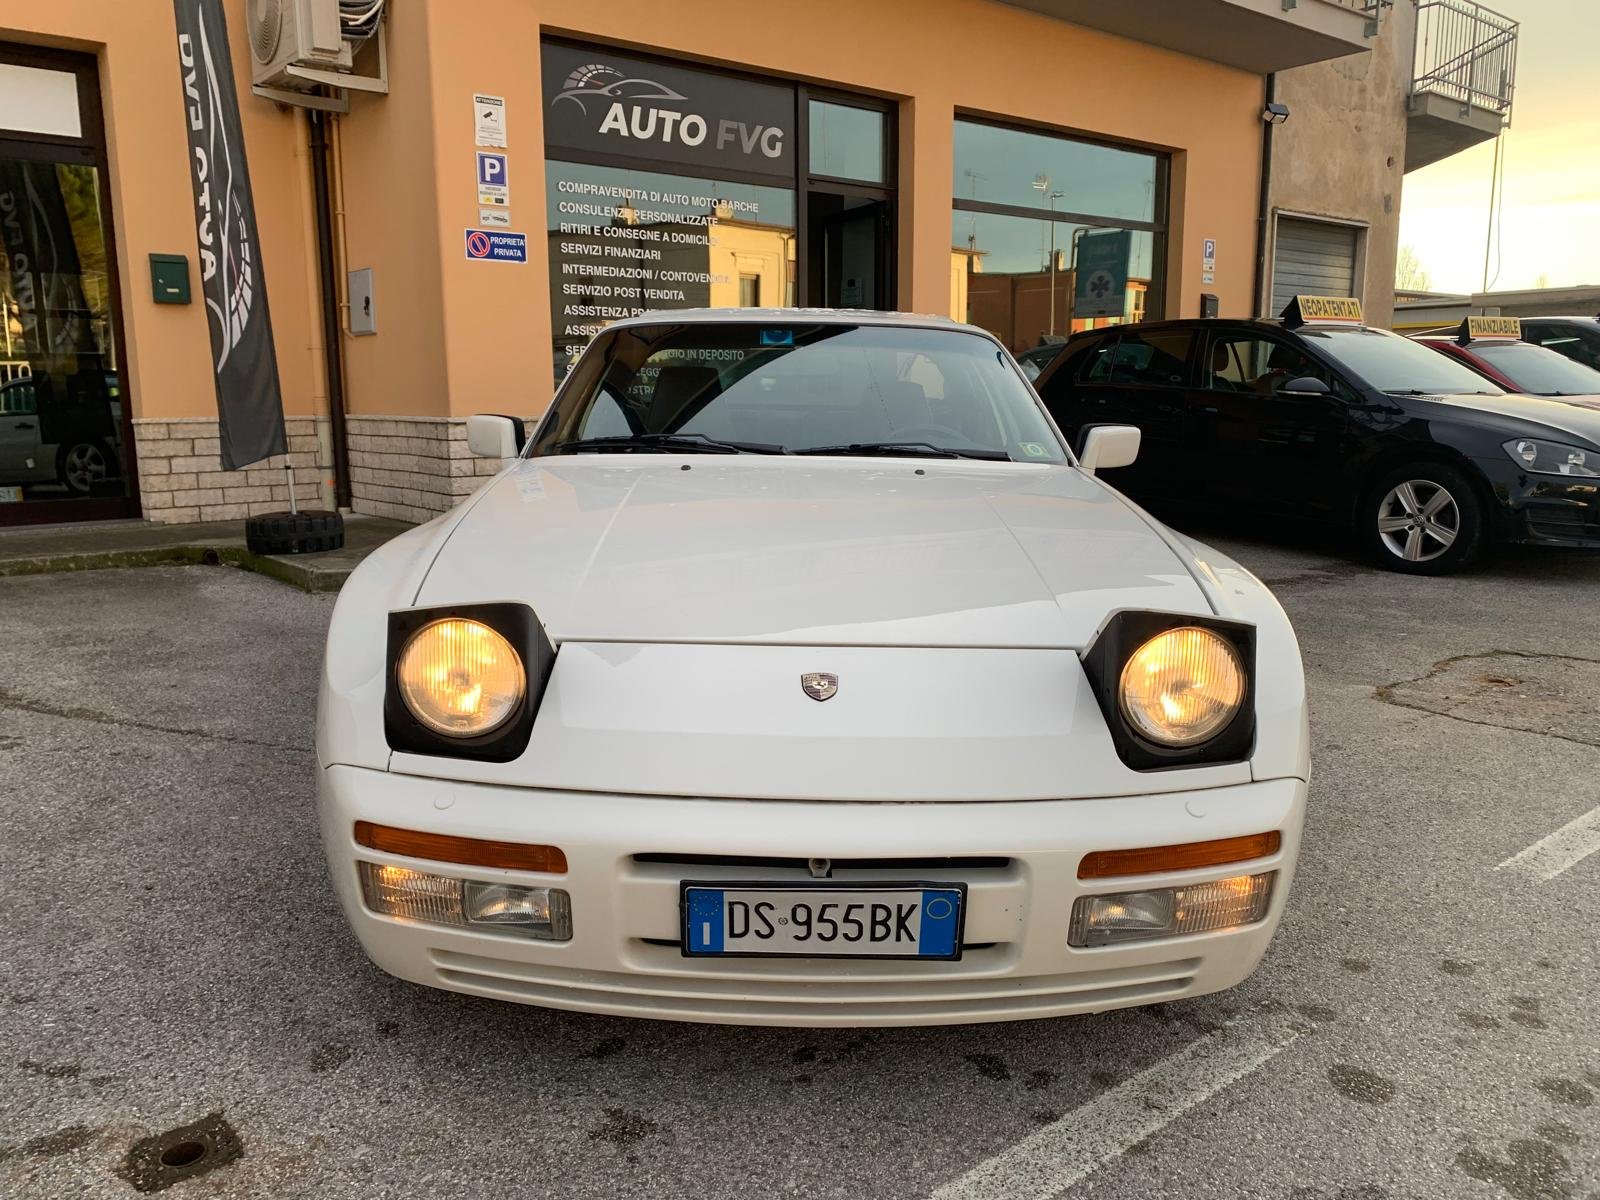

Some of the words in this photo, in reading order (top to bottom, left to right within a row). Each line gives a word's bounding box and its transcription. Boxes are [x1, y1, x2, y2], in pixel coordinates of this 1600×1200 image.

[599, 102, 707, 147] AUTO
[716, 119, 785, 158] FVG
[484, 157, 501, 182] P
[558, 181, 648, 200] COMPRAVENDITA
[650, 191, 660, 202] DI
[662, 193, 689, 206] AUTO
[691, 196, 719, 209] MOTO
[720, 199, 759, 213] BARCHE
[633, 209, 719, 227] PERSONALIZZATE
[560, 222, 592, 236] RITIRI
[594, 225, 601, 236] E
[603, 226, 661, 242] CONSEGNE
[662, 231, 670, 242] A
[494, 247, 522, 257] PRIVATA
[560, 242, 602, 256] SERVIZI
[604, 245, 661, 260] FINANZIARI
[1206, 242, 1214, 257] P
[562, 263, 653, 280] INTERMEDIAZIONI
[562, 283, 612, 297] SERVIZIO
[614, 286, 641, 299] POST
[643, 288, 685, 301] VENDITA
[563, 304, 629, 318] ASSISTENZA
[1300, 298, 1361, 319] NEOPATENTATI
[1470, 319, 1519, 335] FINANZIABILE
[687, 349, 697, 360] IN
[699, 349, 745, 361] DEPOSITO
[727, 900, 776, 940] DS
[791, 903, 919, 943] 955BK
